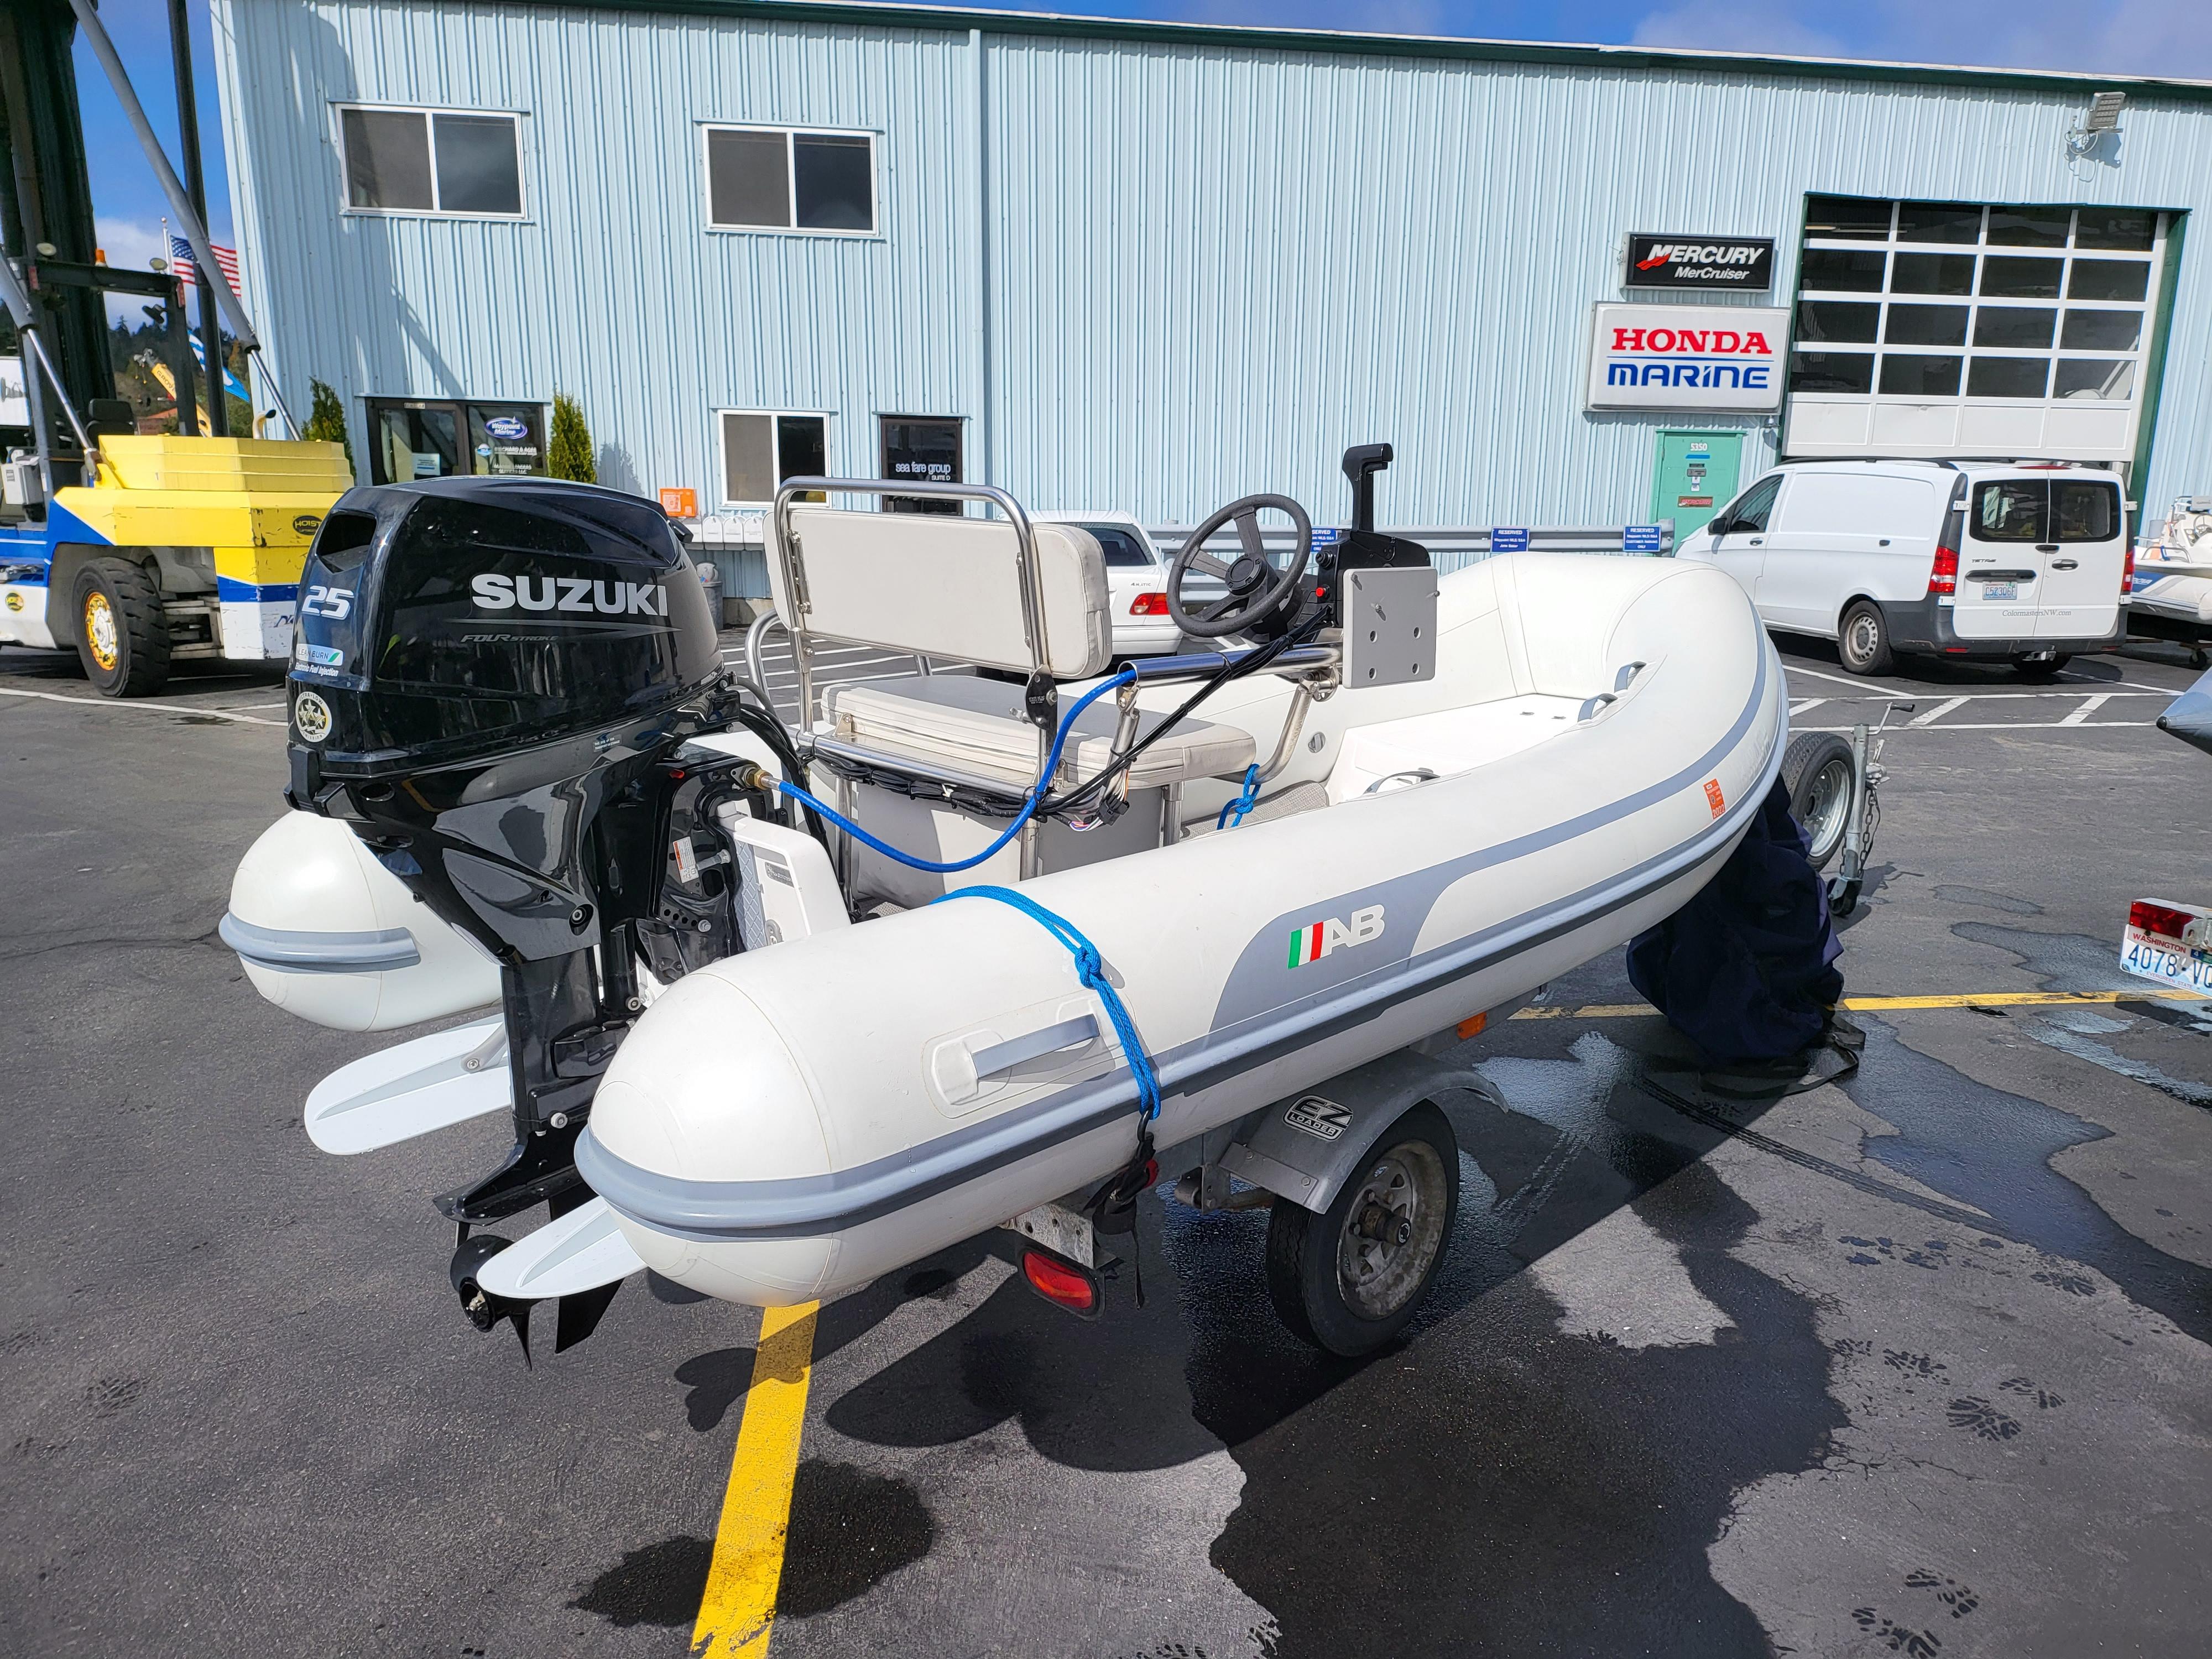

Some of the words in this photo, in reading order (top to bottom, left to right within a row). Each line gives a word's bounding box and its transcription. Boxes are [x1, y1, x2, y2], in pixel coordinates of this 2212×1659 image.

[1647, 244, 1765, 264] MERCURY
[1674, 266, 1750, 280] MerCruiser
[1611, 328, 1772, 354] HONDA
[156, 370, 174, 392] GROV
[896, 463, 910, 472] sea
[911, 461, 926, 473] fare
[928, 464, 951, 474] group
[301, 585, 354, 620] 25
[472, 573, 668, 617] SUZUKI
[312, 651, 329, 659] BURN
[309, 664, 320, 673] Fuel
[318, 666, 339, 676] Injection
[1713, 804, 1725, 818] 2022
[1319, 904, 1385, 958] AB
[2133, 933, 2187, 953] WASHINGTON
[2146, 971, 2176, 983] EVERGREEN
[2177, 980, 2193, 989] STATE
[1293, 1098, 1353, 1129] EZ
[1290, 1113, 1336, 1136] LOADER
